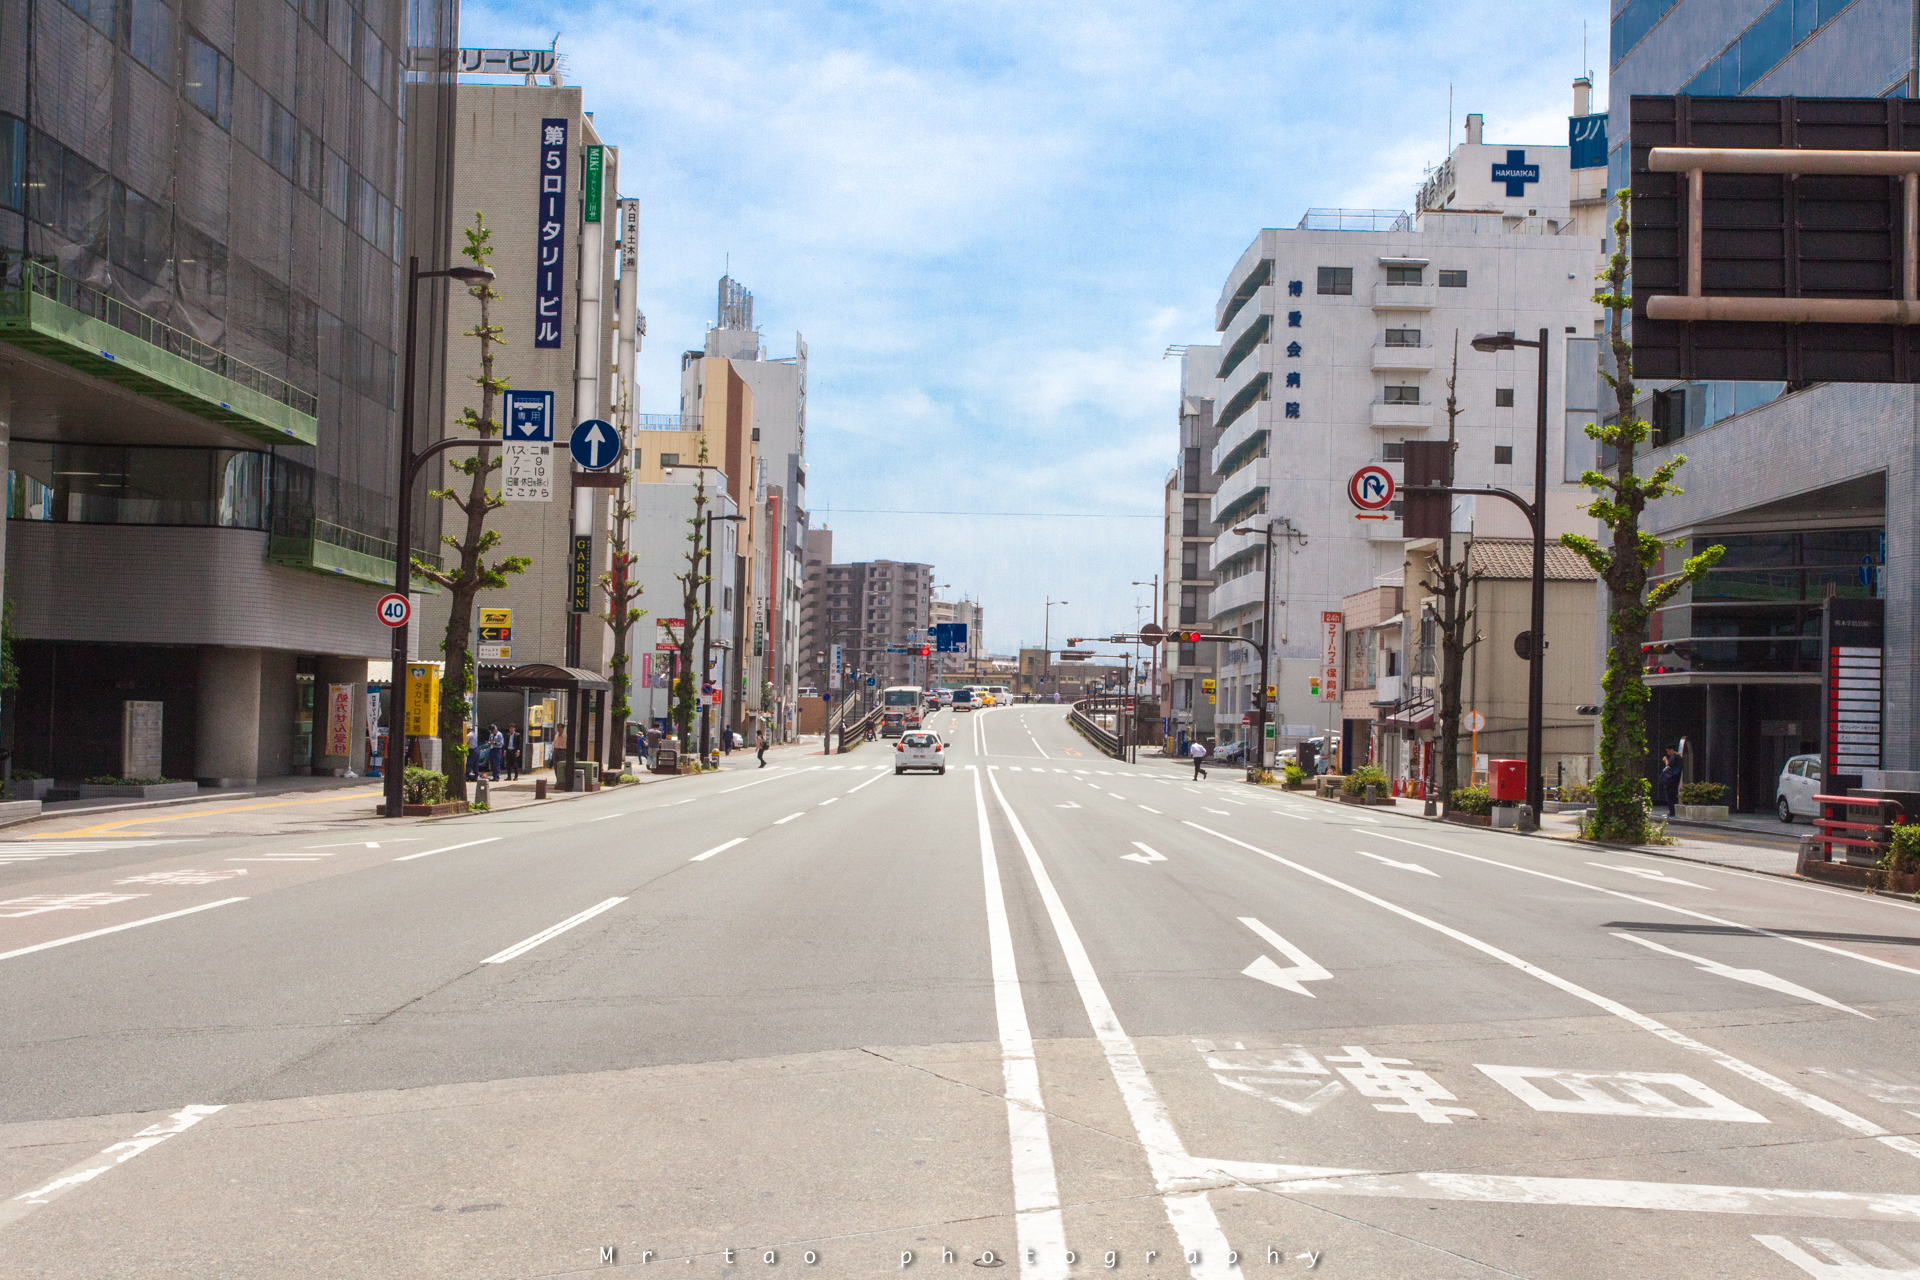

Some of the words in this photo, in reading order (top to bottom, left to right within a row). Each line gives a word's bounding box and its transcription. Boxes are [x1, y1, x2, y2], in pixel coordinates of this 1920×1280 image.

[1495, 169, 1536, 178] HAKUAIKAI
[537, 125, 565, 342] 第5ロータリービル
[1285, 280, 1303, 419] 博愛会病院
[517, 411, 541, 422] 専用
[505, 488, 549, 498] ここから
[575, 540, 586, 608] GARDEN
[384, 603, 403, 618] 40
[1326, 614, 1340, 622] 24h
[500, 629, 509, 640] P
